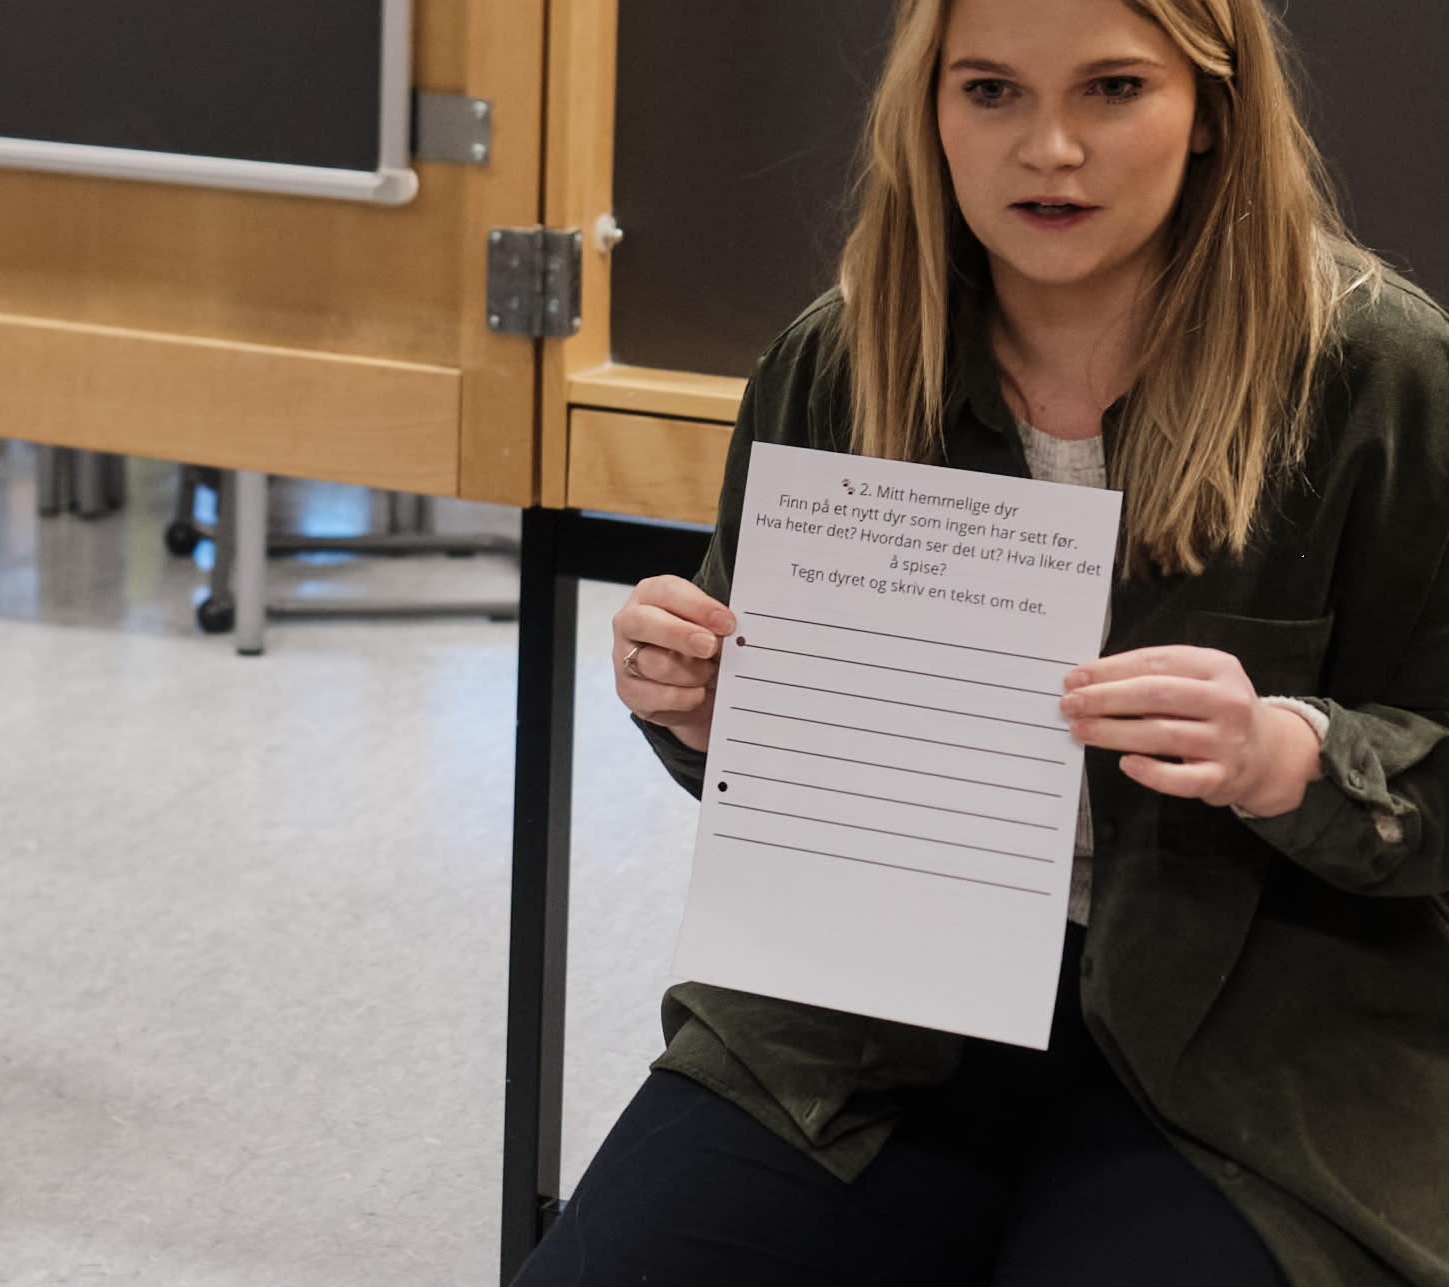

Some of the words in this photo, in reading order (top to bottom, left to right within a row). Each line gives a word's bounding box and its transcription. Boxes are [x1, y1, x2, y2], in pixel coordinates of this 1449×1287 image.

[778, 494, 808, 510] Finn
[811, 499, 830, 515] på
[834, 504, 847, 516] et
[852, 506, 879, 522] nytt
[883, 509, 906, 527] dyr
[910, 515, 942, 529] som
[945, 517, 986, 537] ingen
[990, 524, 1016, 540] har
[1019, 531, 1048, 545] sett
[1051, 532, 1078, 550] før.
[859, 482, 872, 497] 2.
[876, 485, 904, 502] Mitt
[908, 489, 990, 516] hemmelige
[994, 502, 1020, 520] dyr
[755, 513, 782, 529] Hva
[785, 518, 823, 535] heter
[826, 524, 857, 540] det?
[860, 528, 922, 549] Hvordan
[926, 539, 949, 553] ser
[952, 542, 976, 558] det
[980, 548, 1004, 562] ut?
[1006, 549, 1035, 566] Hva
[1039, 554, 1072, 571] liker
[1076, 561, 1103, 577] det
[889, 554, 899, 569] å
[902, 558, 947, 576] spise?
[790, 563, 824, 583] Tegn
[828, 569, 865, 587] dyret
[869, 578, 887, 594] og
[891, 579, 925, 597] skriv
[928, 586, 946, 599] en
[950, 589, 986, 606] tekst
[990, 596, 1014, 610] om
[1018, 598, 1047, 615] det.
